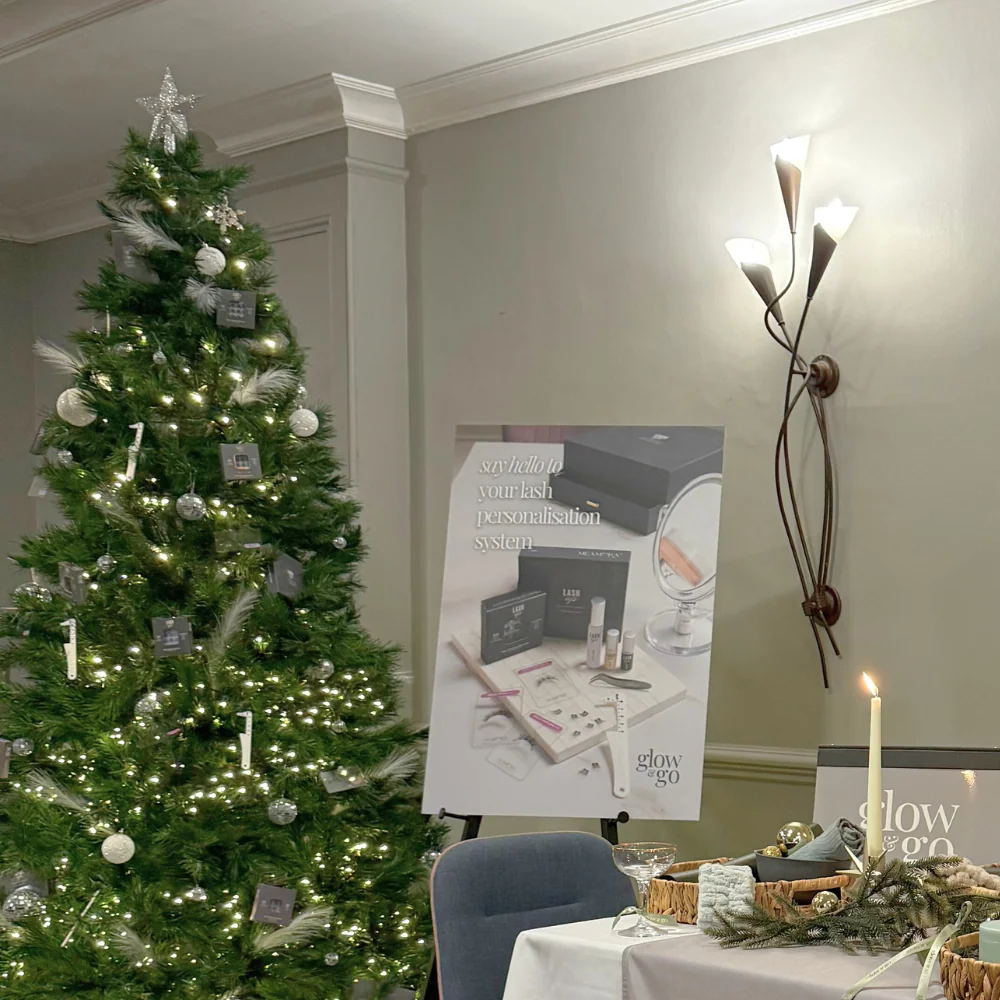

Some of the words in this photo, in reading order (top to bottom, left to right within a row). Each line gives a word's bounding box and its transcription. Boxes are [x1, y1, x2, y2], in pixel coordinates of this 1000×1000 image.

[479, 459, 507, 477] say
[508, 455, 545, 474] hello
[546, 458, 565, 477] to
[478, 485, 518, 502] your
[520, 481, 553, 499] lash
[477, 507, 600, 528] personalisation
[474, 533, 533, 553] system
[635, 748, 683, 773] glow
[647, 768, 656, 778] &
[654, 769, 680, 788] go
[881, 835, 899, 852] &
